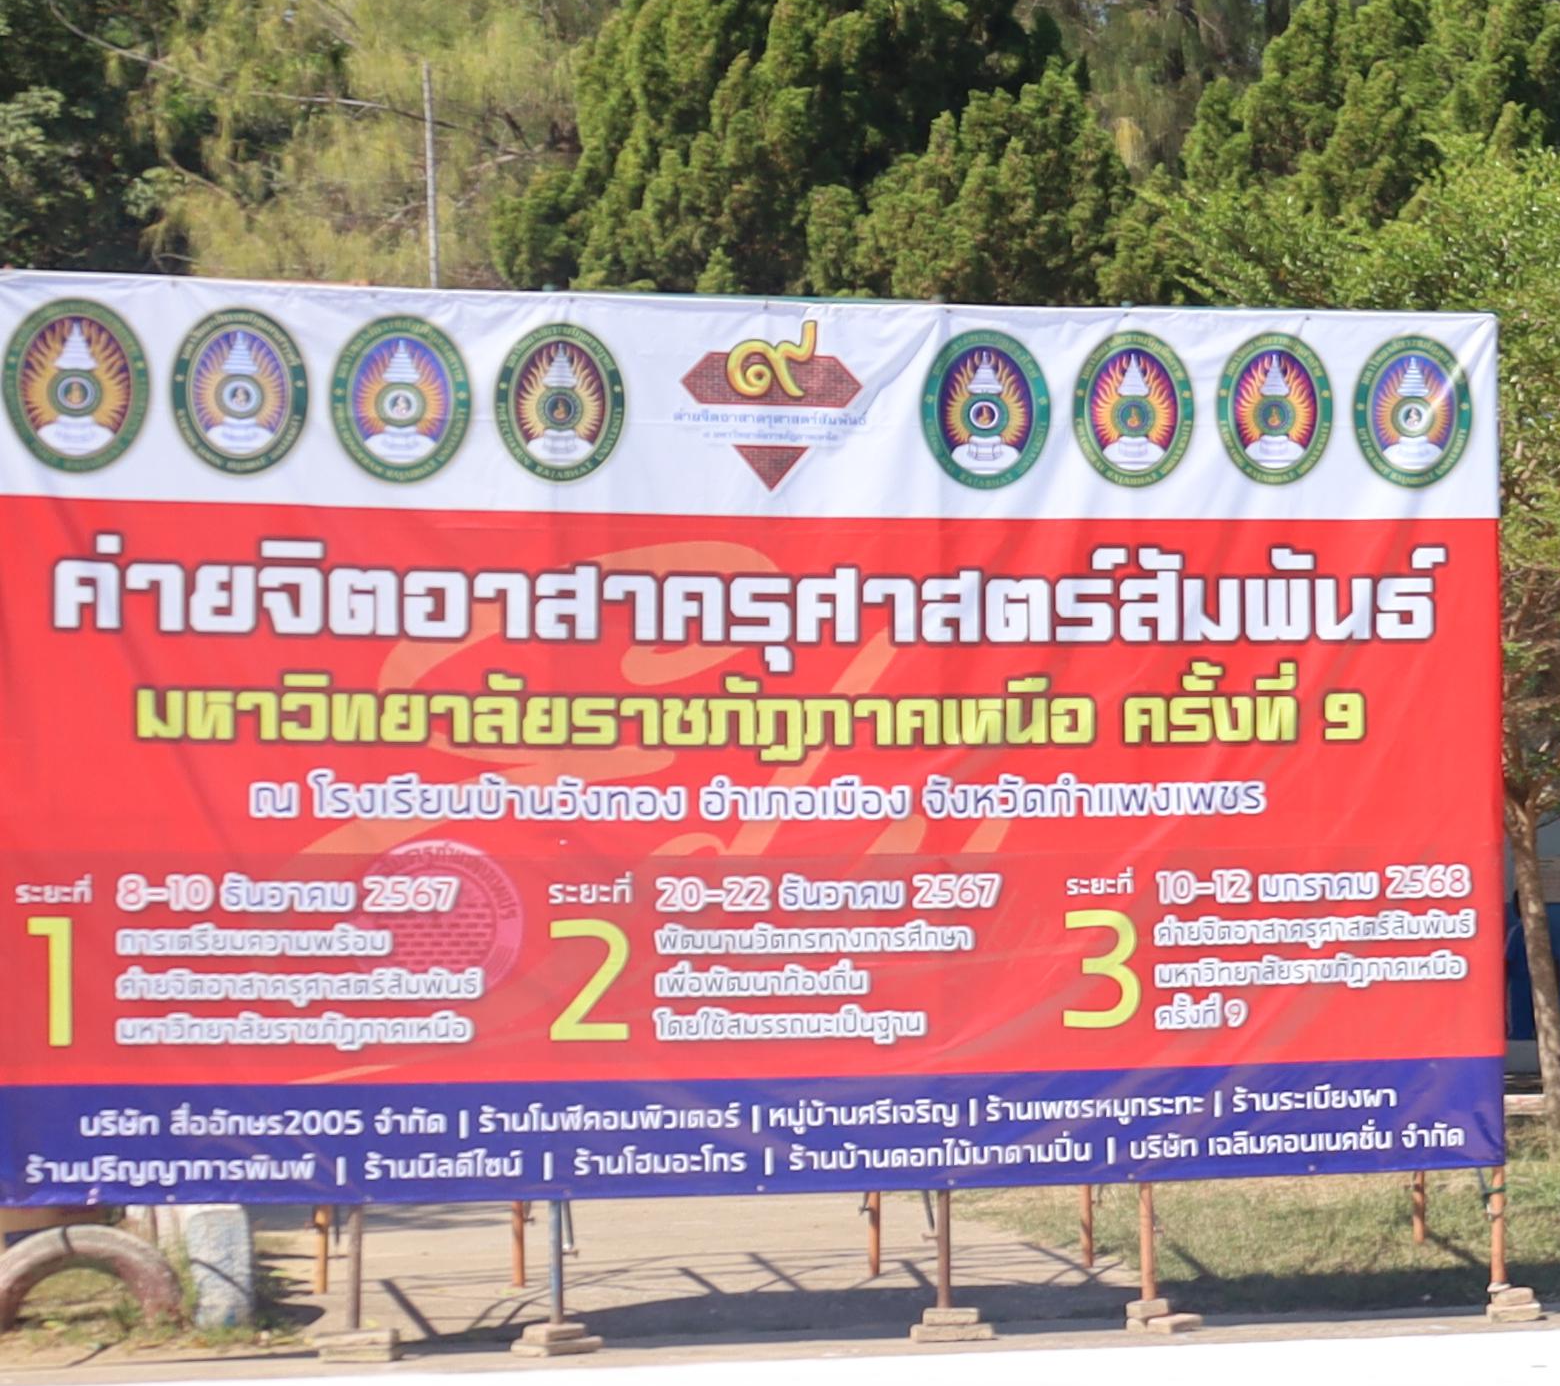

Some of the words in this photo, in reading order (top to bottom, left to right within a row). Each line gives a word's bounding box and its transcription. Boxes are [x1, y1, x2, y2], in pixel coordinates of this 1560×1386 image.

[51, 532, 1448, 674] ค่ายจิตอาสาครุศาสตร์สัมพันธ์
[134, 671, 1097, 763] มหาวิทยาลัยราชภัฏภาคเหนือ
[1122, 660, 1300, 745] ครั้งที่
[248, 778, 297, 819] ณ
[308, 768, 685, 822] โรงเรียนบ้านวังทอง
[698, 774, 909, 821] อำเภอเมือง
[921, 773, 1267, 818] จังหวัดกำแพงเพชร
[15, 875, 92, 905] ระยะที่
[218, 871, 357, 910] ธันวาคม
[361, 875, 460, 912] 2567
[547, 871, 633, 906] ระยะที่
[778, 872, 906, 910] ธันวาคม
[911, 872, 1002, 909] 2567
[1066, 867, 1135, 896] ระยะที่
[1258, 871, 1379, 904] มกราคม
[1384, 863, 1472, 900] 2568
[115, 921, 393, 957] การเตรียมความพร้อม
[653, 919, 975, 955] พัฒนานวัตกรทางการศึกษา
[1152, 908, 1478, 949] ค่ายจิตอาสาครุศาสตร์สัมพันธ์
[27, 916, 72, 1047] 1
[115, 965, 485, 1009] ค่ายจิตอาสาครุศาสตร์สัมพันธ์
[550, 918, 631, 1042] 2
[655, 959, 871, 998] เพื่อพัฒนาท้องถิ่น
[1062, 908, 1143, 1029] 3
[1153, 949, 1469, 989] มหาวิทยาลัยราชภัฏภาคเหนือ
[115, 1010, 475, 1051] มหาวิทยาลัยราชภัฏภาคเหนือ
[652, 1003, 929, 1045] โดยใช้สมรรถนะเป็นฐาน
[1154, 992, 1223, 1031] ครั้งที่
[1224, 999, 1249, 1027] 9
[80, 1109, 159, 1137] บริษัท
[169, 1103, 362, 1137] สื่ออักษร2005
[373, 1107, 448, 1135] จำกัด
[768, 1098, 959, 1135] หมู่บ้านศรีเจริญ
[986, 1092, 1204, 1126] ร้านเพชรหมูกระทะ
[1233, 1083, 1398, 1114] ร้านระเบียงผา
[25, 1153, 316, 1186] ร้านปริญญาการพิมพ์
[364, 1148, 522, 1181] ร้านนิลดีไซน์
[788, 1130, 1092, 1171] ร้านบ้านดอกไม้มาดามปิ่น
[1129, 1132, 1198, 1160] บริษัท
[1207, 1118, 1393, 1157] เฉลิมคอนเนคชั่น
[1402, 1121, 1465, 1149] จำกัด
